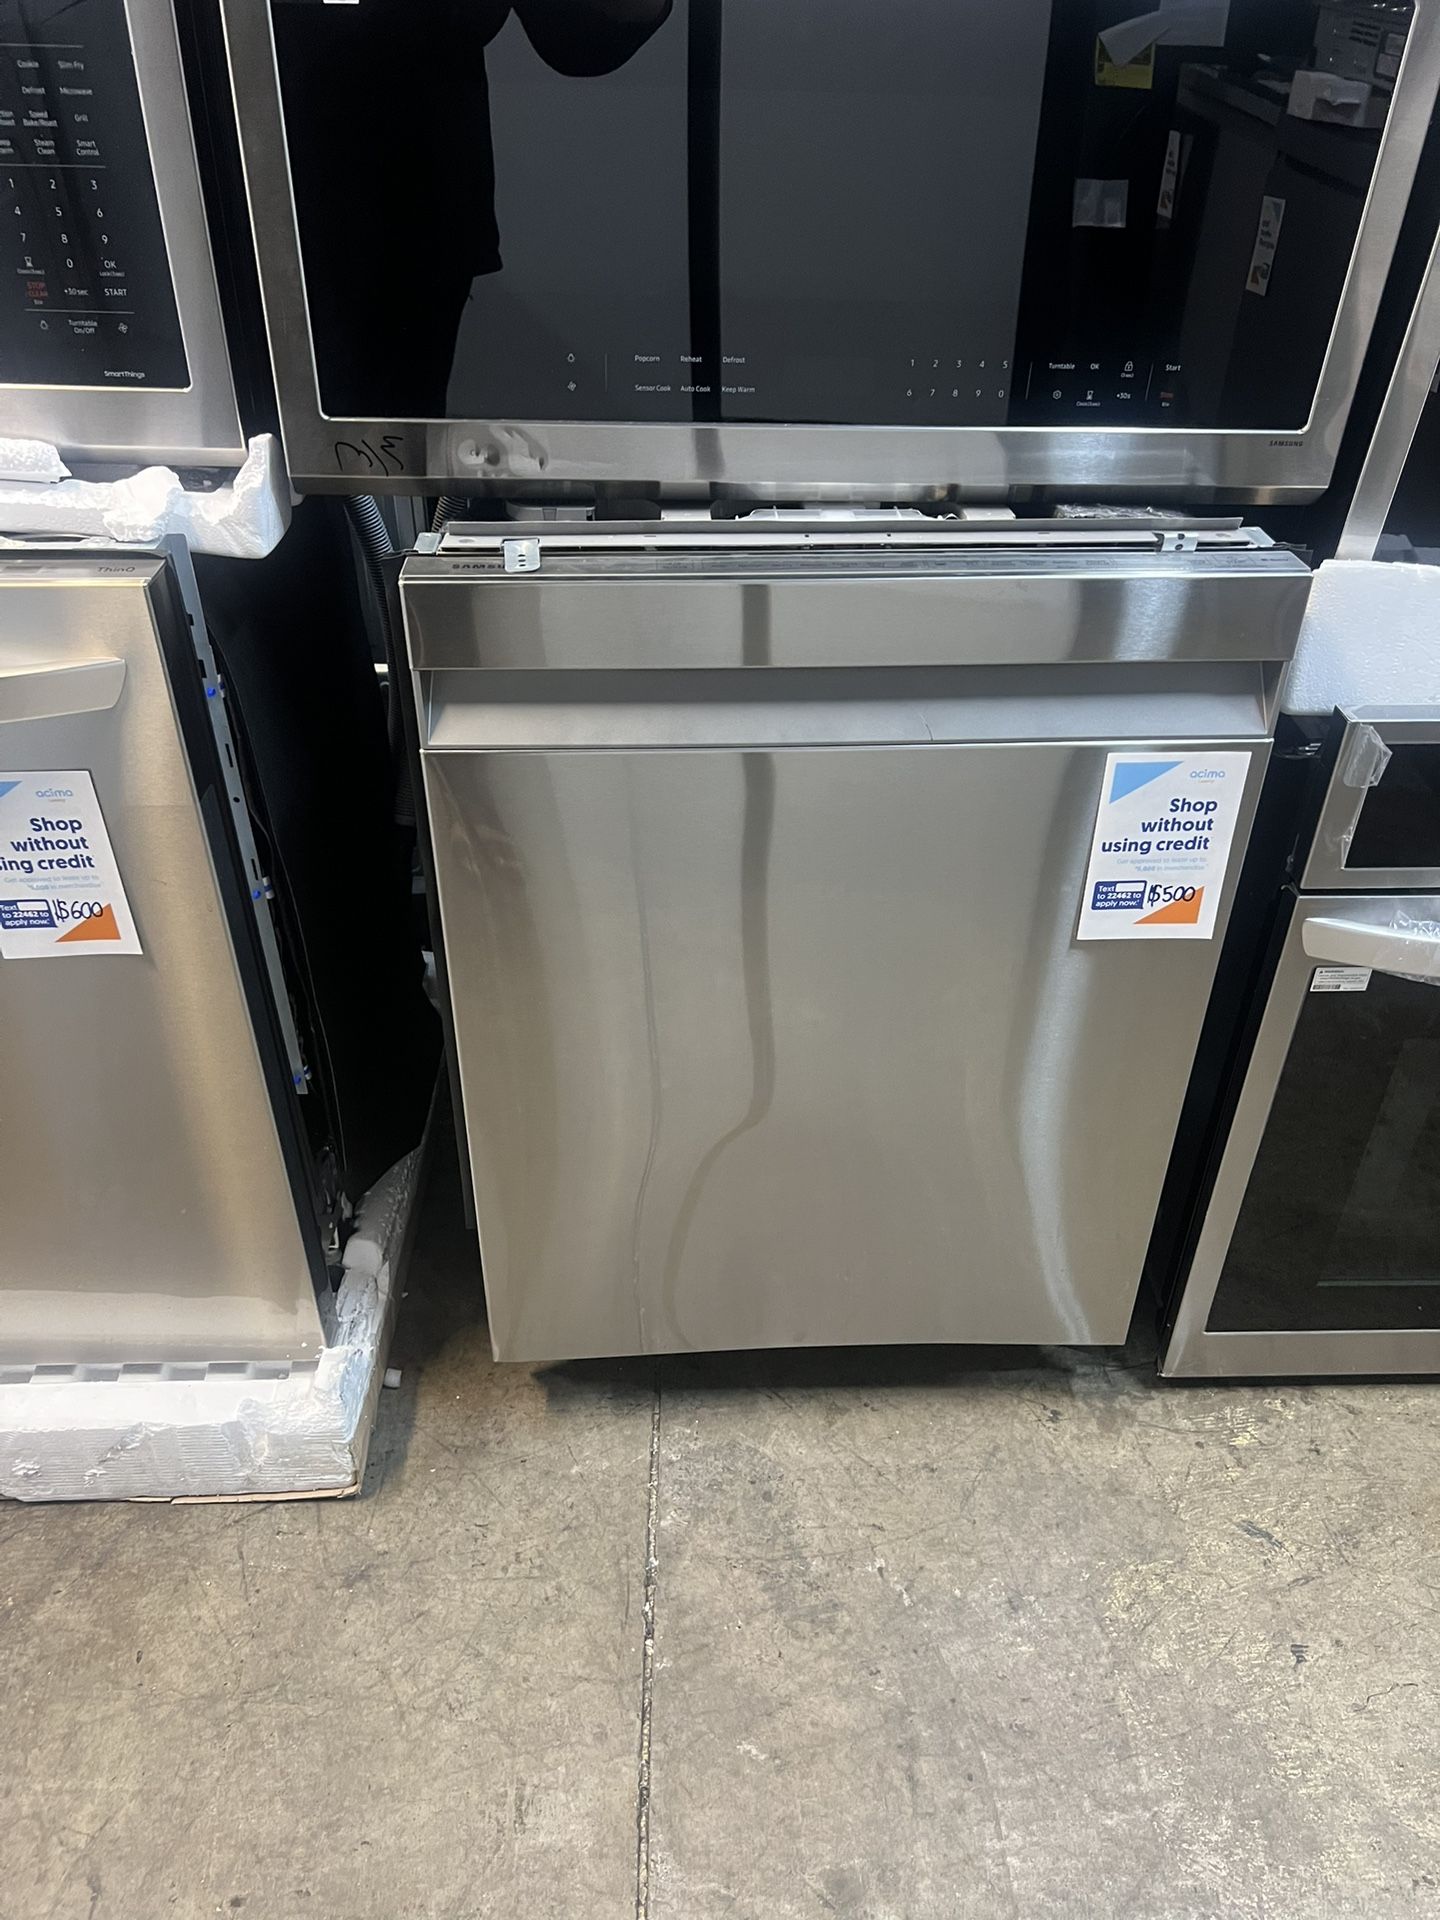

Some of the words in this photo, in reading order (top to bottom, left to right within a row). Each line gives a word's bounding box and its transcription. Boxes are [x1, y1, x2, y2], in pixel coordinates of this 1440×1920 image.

[74, 113, 88, 122] Grill
[77, 147, 99, 155] Control
[9, 178, 14, 188] 1
[50, 179, 56, 189] 2
[91, 179, 98, 190] 3
[14, 206, 21, 215] 4
[56, 207, 62, 216] 5
[97, 208, 103, 217] 6
[20, 232, 26, 242] 7
[61, 234, 68, 243] 8
[102, 234, 108, 244] 9
[104, 260, 117, 269] OK
[104, 288, 127, 297] START
[68, 319, 98, 327] Turntable
[634, 354, 661, 363] Popcorn
[680, 355, 703, 363] Reheat
[722, 356, 746, 364] Defrost
[933, 360, 939, 368] 2
[1003, 361, 1008, 369] 5
[1048, 362, 1076, 371] Turntable
[1165, 364, 1182, 372] Start
[104, 370, 146, 379] SmartThings
[634, 384, 655, 392] Sensor
[680, 385, 695, 393] Auto
[721, 385, 737, 395] Keep
[906, 389, 912, 397] 6
[930, 389, 936, 397] 7
[952, 389, 959, 397] 8
[976, 389, 982, 397] 9
[998, 390, 1004, 398] 0
[1190, 768, 1226, 779] acima
[36, 787, 73, 798] acima
[1169, 797, 1217, 815] Shop
[30, 817, 82, 833] Shop
[1141, 817, 1214, 832] without
[11, 837, 89, 851] without
[1101, 838, 1151, 855] using
[1155, 835, 1210, 851] credit
[38, 854, 95, 869] credit
[1099, 885, 1115, 893] Text
[1107, 892, 1132, 900] 22462
[5, 920, 28, 928] apply
